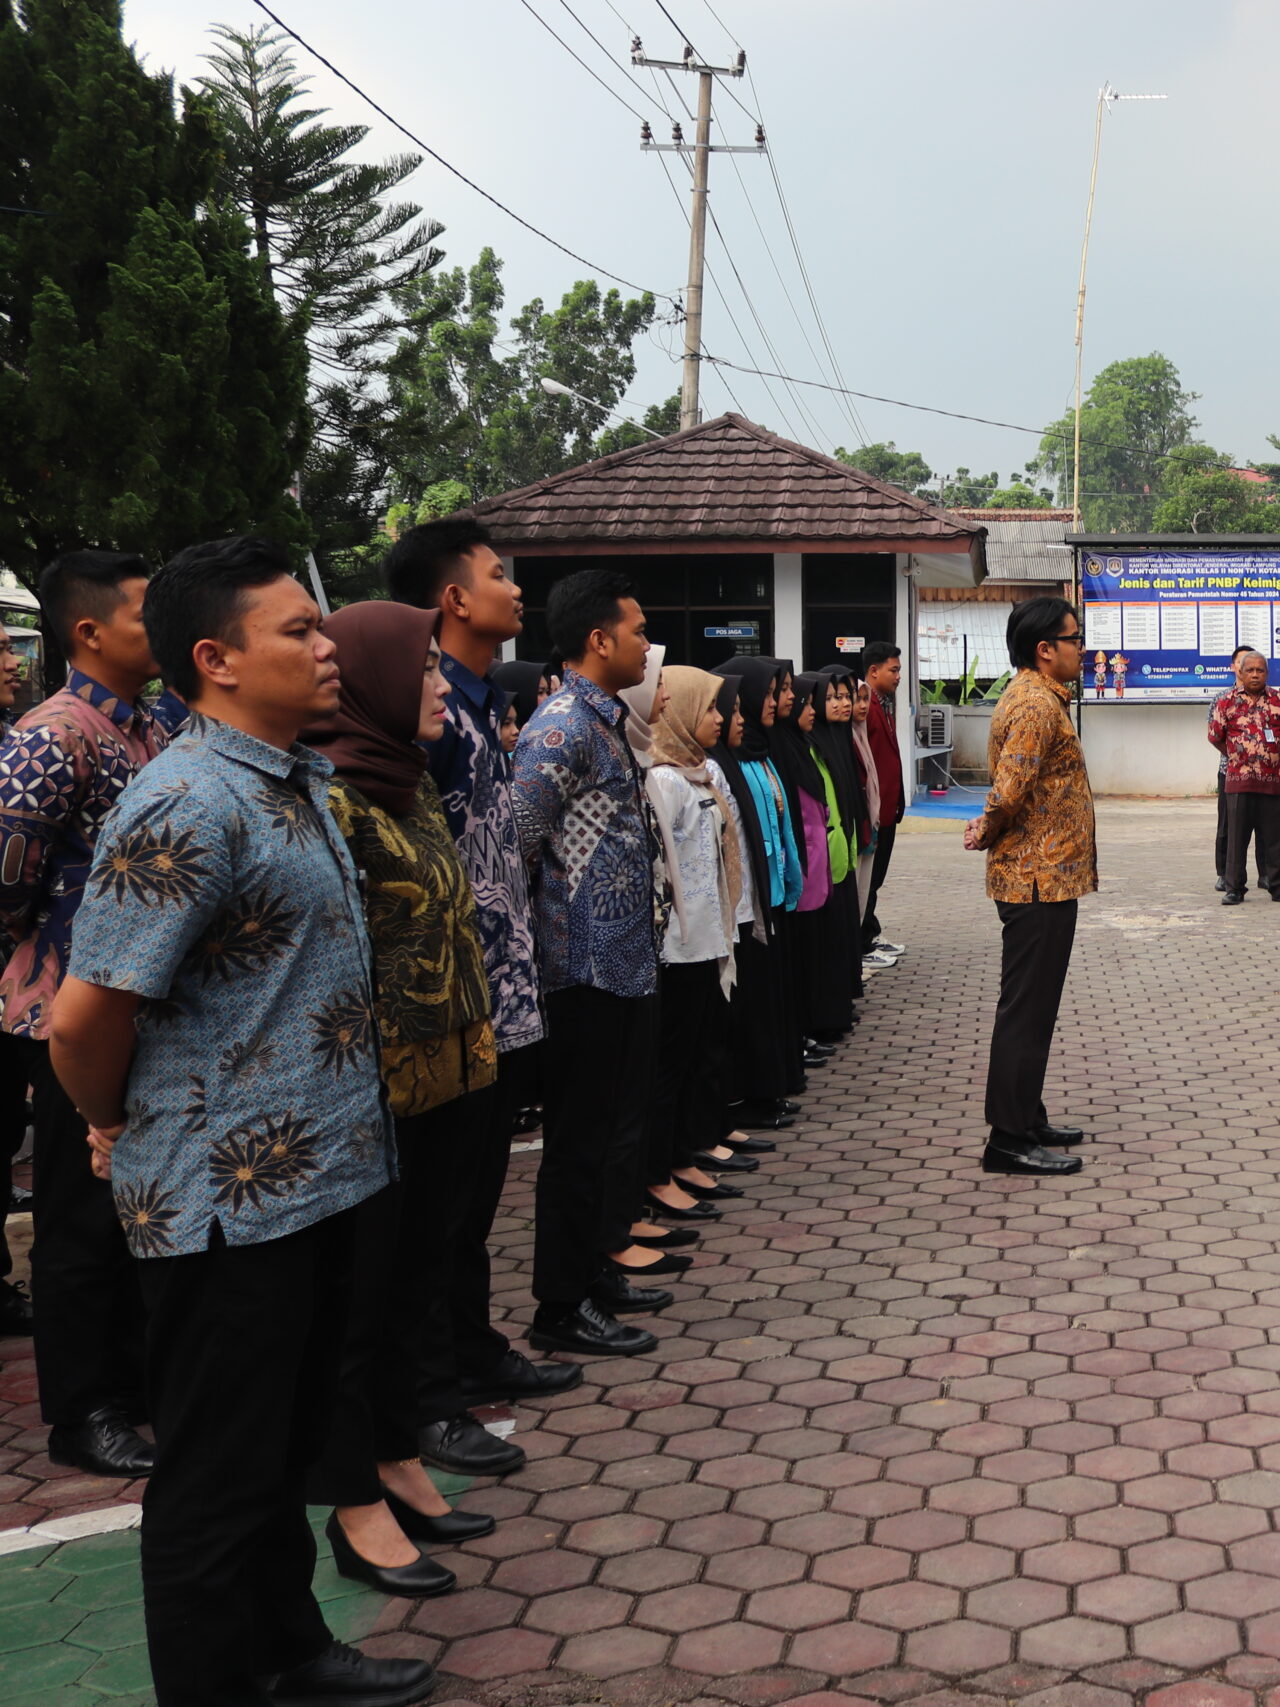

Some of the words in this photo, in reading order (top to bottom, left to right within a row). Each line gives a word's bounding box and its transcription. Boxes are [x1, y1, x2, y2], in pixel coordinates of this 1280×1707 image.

[1119, 577, 1151, 589] Jenis
[1153, 577, 1176, 589] dan
[1178, 577, 1205, 589] Tarif
[1207, 577, 1241, 588] PNBP
[1265, 590, 1280, 598] 2024
